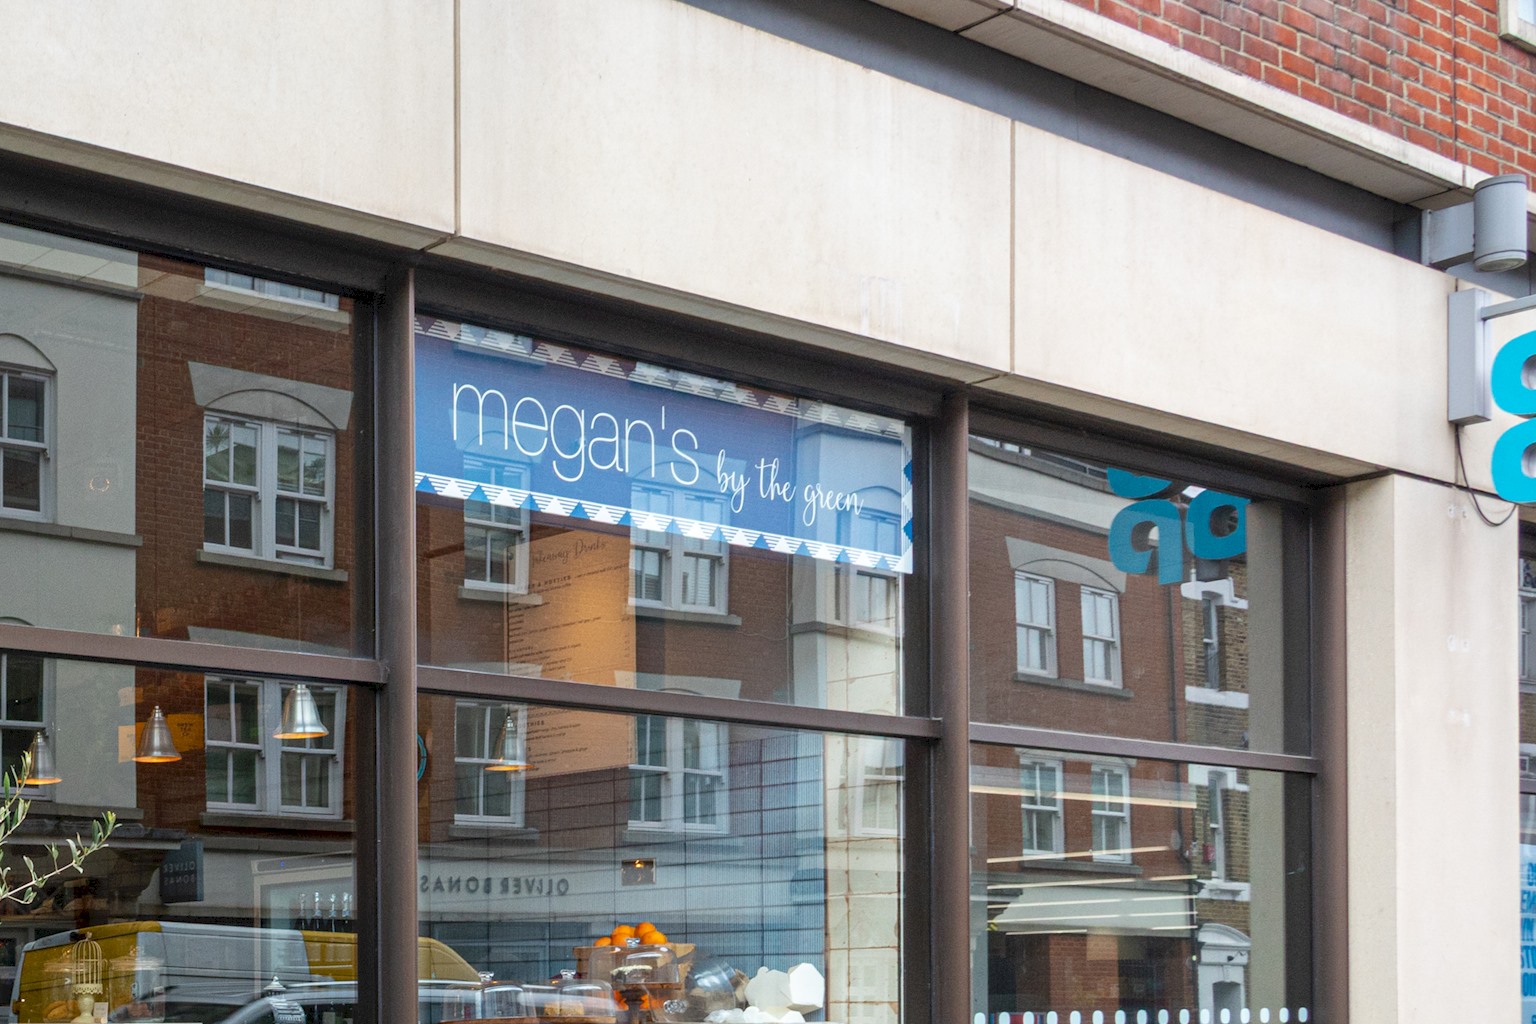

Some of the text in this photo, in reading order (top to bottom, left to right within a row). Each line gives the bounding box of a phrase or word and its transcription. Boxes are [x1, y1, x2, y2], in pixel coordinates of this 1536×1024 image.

[452, 381, 865, 527] megan's by the green
